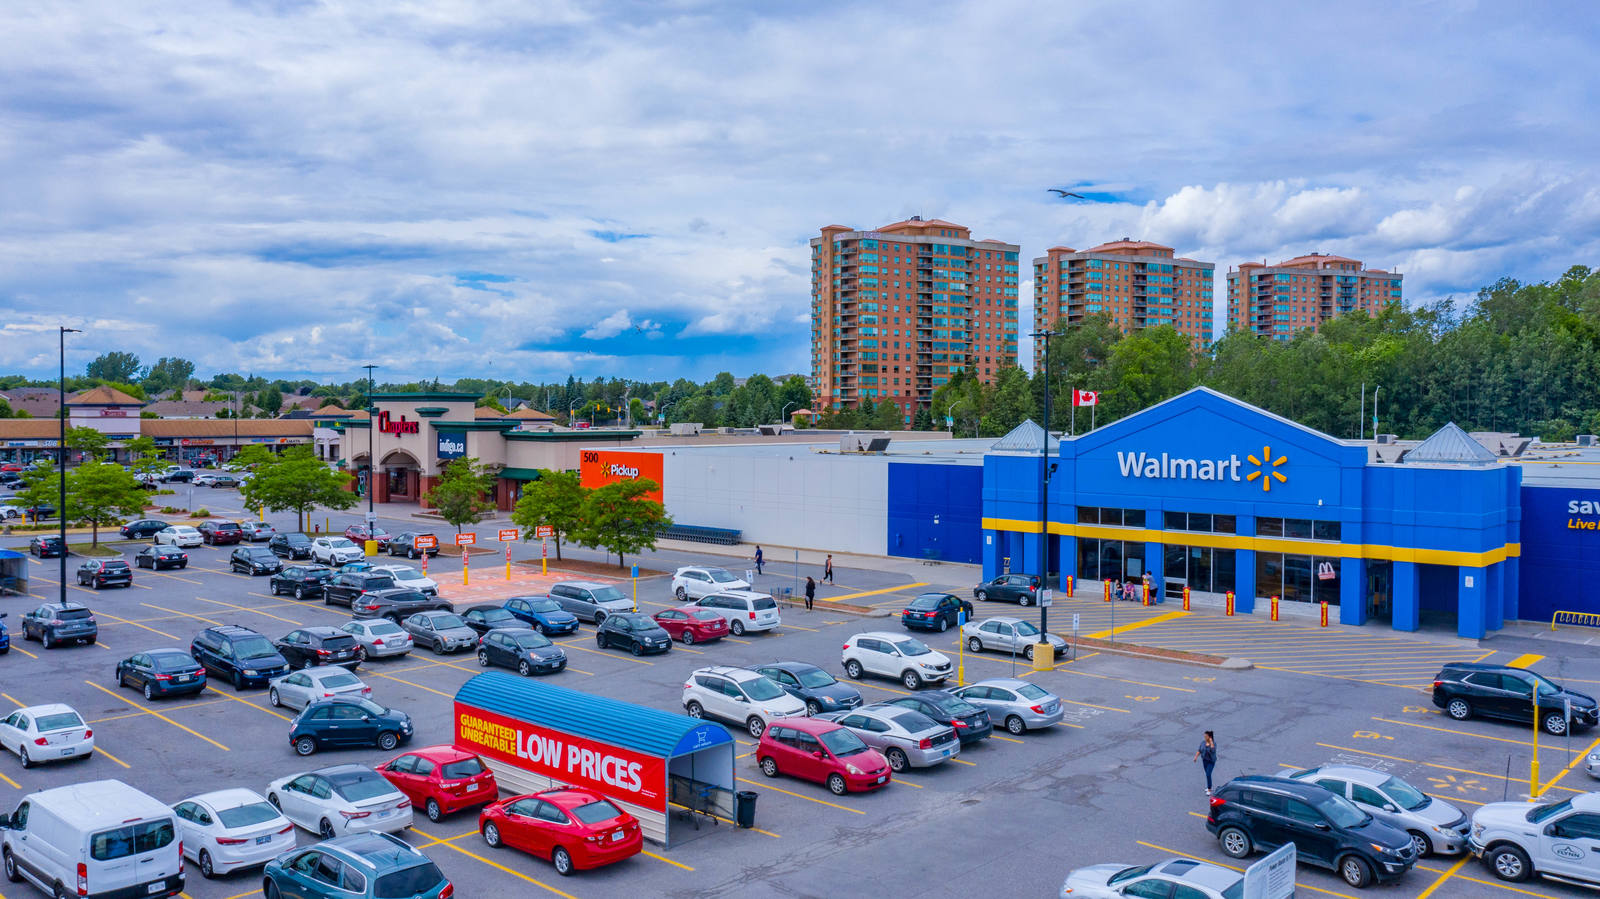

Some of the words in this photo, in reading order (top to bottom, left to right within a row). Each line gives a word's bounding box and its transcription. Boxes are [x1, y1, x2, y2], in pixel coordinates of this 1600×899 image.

[378, 410, 419, 438] Chapters
[439, 439, 464, 455] indigo.ca
[583, 452, 599, 463] 500
[610, 464, 639, 479] Pickup
[1117, 451, 1241, 482] Walmart
[1568, 518, 1596, 530] Live
[460, 713, 517, 741] GUARANTEED
[460, 725, 517, 756] UNBEATABLE
[516, 729, 562, 769] LOW
[567, 744, 643, 793] PRICES
